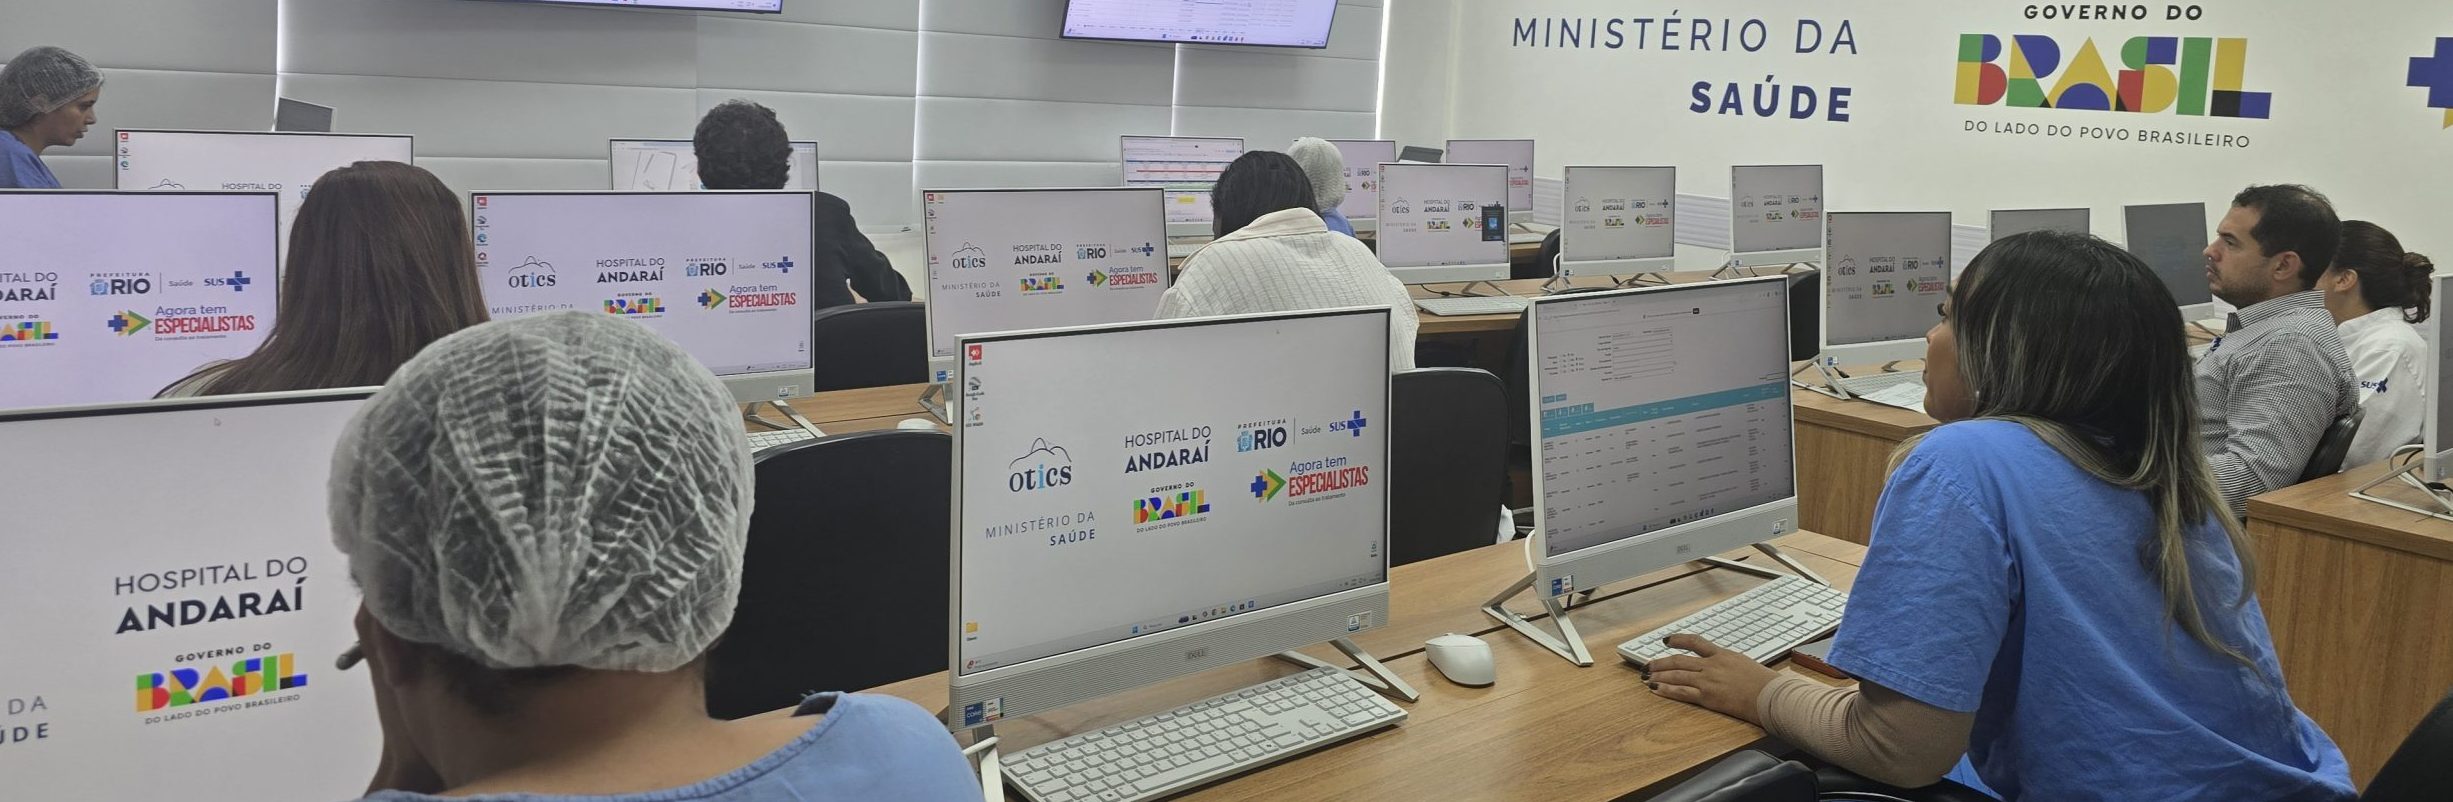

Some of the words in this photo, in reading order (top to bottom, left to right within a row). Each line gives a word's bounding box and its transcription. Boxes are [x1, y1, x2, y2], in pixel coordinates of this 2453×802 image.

[2024, 4, 2147, 20] GOVERNO
[2166, 5, 2202, 20] DO
[1512, 10, 1767, 52] MINISTÉRIO
[1795, 19, 1857, 54] DA
[1954, 34, 2272, 119] BRASIL
[1689, 75, 1851, 122] SAÚDE
[1965, 120, 1987, 132] DO
[1995, 122, 2039, 135] LADO
[2047, 125, 2072, 137] DO
[2080, 127, 2129, 140] POVO
[2138, 130, 2250, 148] BRASILEIRO
[1013, 244, 1048, 252] HOSPITAL
[1086, 247, 1106, 259] RIO
[596, 258, 647, 267] HOSPITAL
[649, 257, 664, 266] DO
[762, 261, 776, 269] SUS
[952, 255, 985, 268] otics
[1014, 251, 1062, 265] ANDARAÍ
[0, 272, 31, 282] ITAL
[35, 272, 57, 281] DO
[596, 266, 664, 283] ANDARAÍ
[700, 262, 727, 276] RIO
[1109, 266, 1129, 274] Agora
[111, 278, 151, 295] RIO
[168, 279, 193, 287] Saúde
[204, 277, 224, 286] SUS
[508, 271, 556, 288] otics
[942, 282, 987, 290] MINISTÉRIO
[1109, 272, 1158, 285] ESPECIALISTAS
[0, 282, 58, 301] ARAÍ
[729, 285, 757, 294] Agora
[975, 289, 1001, 298] SAÚDE
[729, 292, 796, 308] ESPECIALISTAS
[155, 305, 196, 318] Agora
[200, 304, 227, 315] tem
[155, 315, 254, 335] ESPECIALISTAS
[1238, 418, 1286, 429] PREFEITURA
[1301, 425, 1321, 435] Saúde
[1329, 421, 1346, 432] SUS
[1125, 428, 1188, 448] HOSPITAL
[1192, 425, 1211, 439] DO
[1254, 426, 1287, 450] RIO
[1125, 438, 1211, 473] ANDARAÍ
[1289, 460, 1322, 475] Agora
[1325, 456, 1347, 468] tem
[1009, 464, 1072, 492] otics
[1288, 465, 1369, 497] ESPECIALISTAS
[1150, 483, 1182, 493] GOVERNO
[1133, 490, 1210, 525] BRASIL
[985, 516, 1070, 539] MINISTÉRIO
[1077, 511, 1095, 523] DA
[1050, 528, 1095, 546] SAÚDE
[115, 562, 257, 595] HOSPITAL
[266, 556, 307, 577] DO
[115, 576, 308, 634] ANDARAÍ
[175, 646, 244, 662] GOVERNO
[253, 642, 272, 651] DO
[136, 652, 307, 712] BRASIL
[8, 695, 48, 715] DA
[145, 716, 161, 725] DO
[164, 711, 192, 722] LADO
[195, 707, 211, 716] DO
[214, 703, 242, 713] POVO
[245, 693, 301, 709] BRASILEIRO
